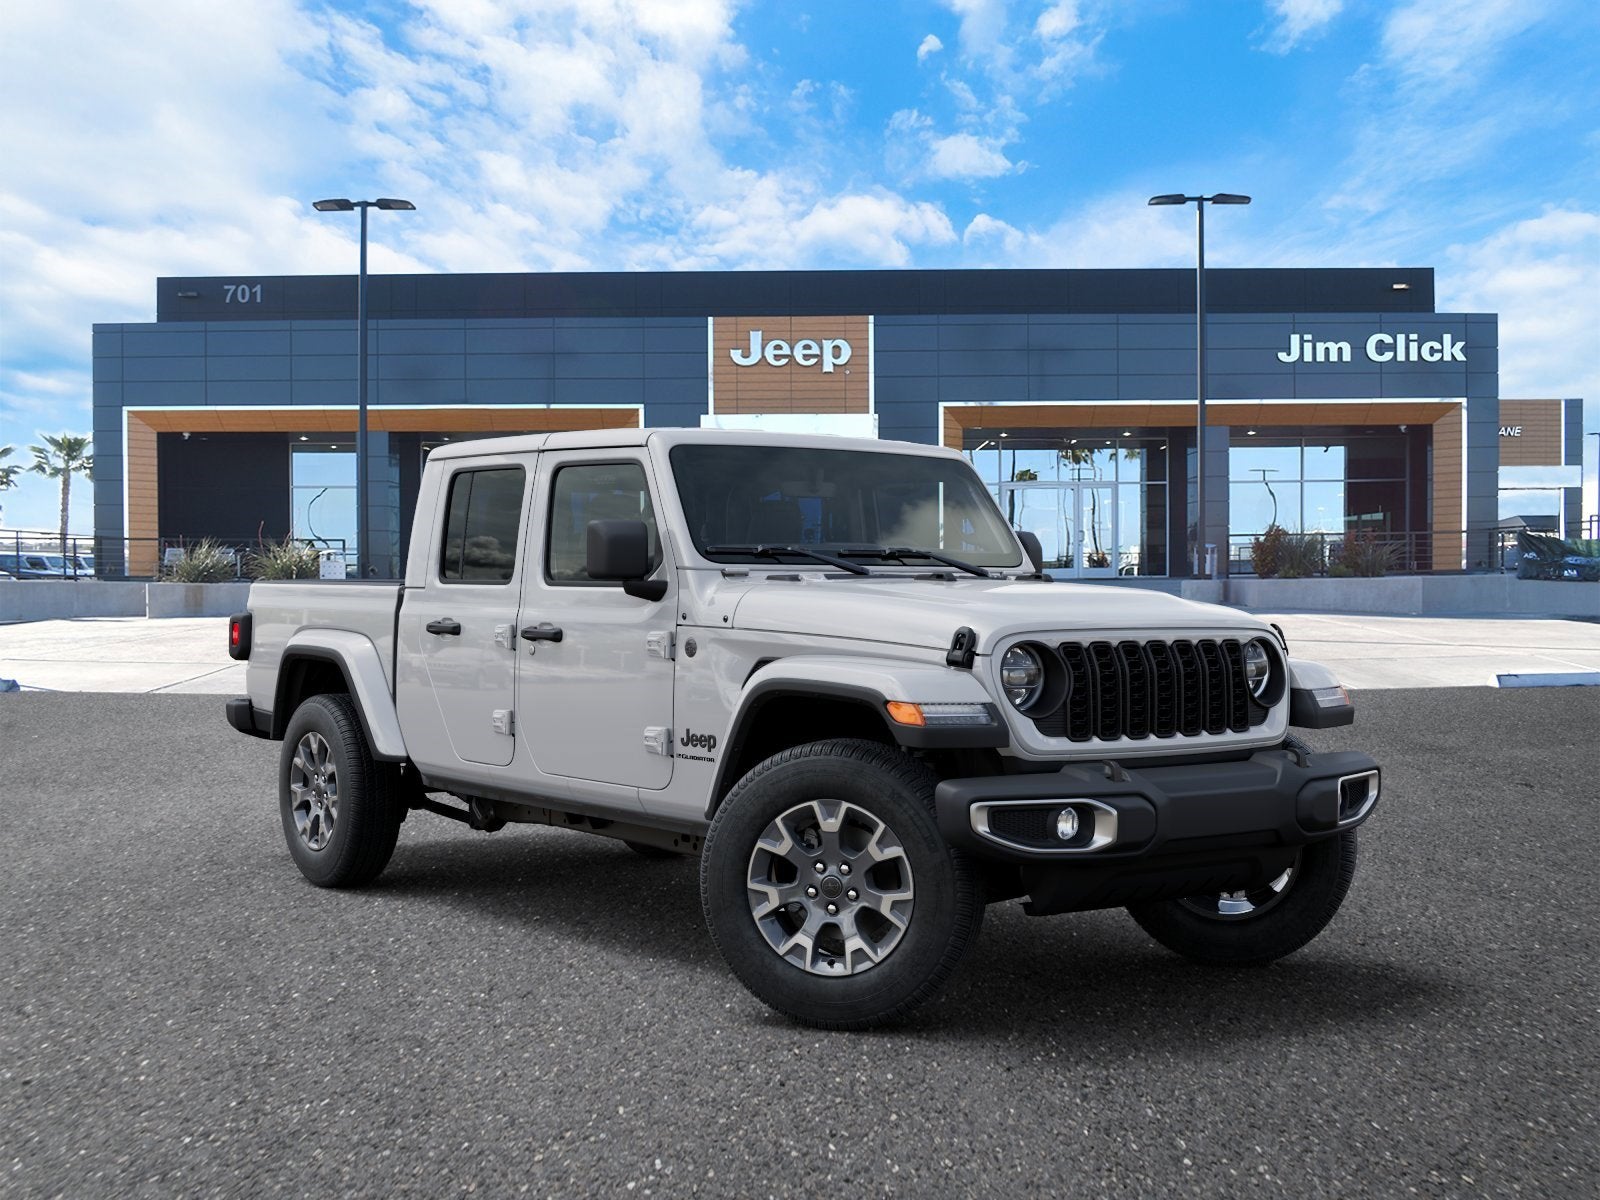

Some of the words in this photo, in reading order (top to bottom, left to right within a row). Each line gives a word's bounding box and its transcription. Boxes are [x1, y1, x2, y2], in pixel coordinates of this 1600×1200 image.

[223, 284, 261, 303] 701
[730, 330, 852, 374] Jeep
[1277, 333, 1351, 363] Jim
[1365, 333, 1467, 363] Click
[681, 728, 717, 752] Jeep
